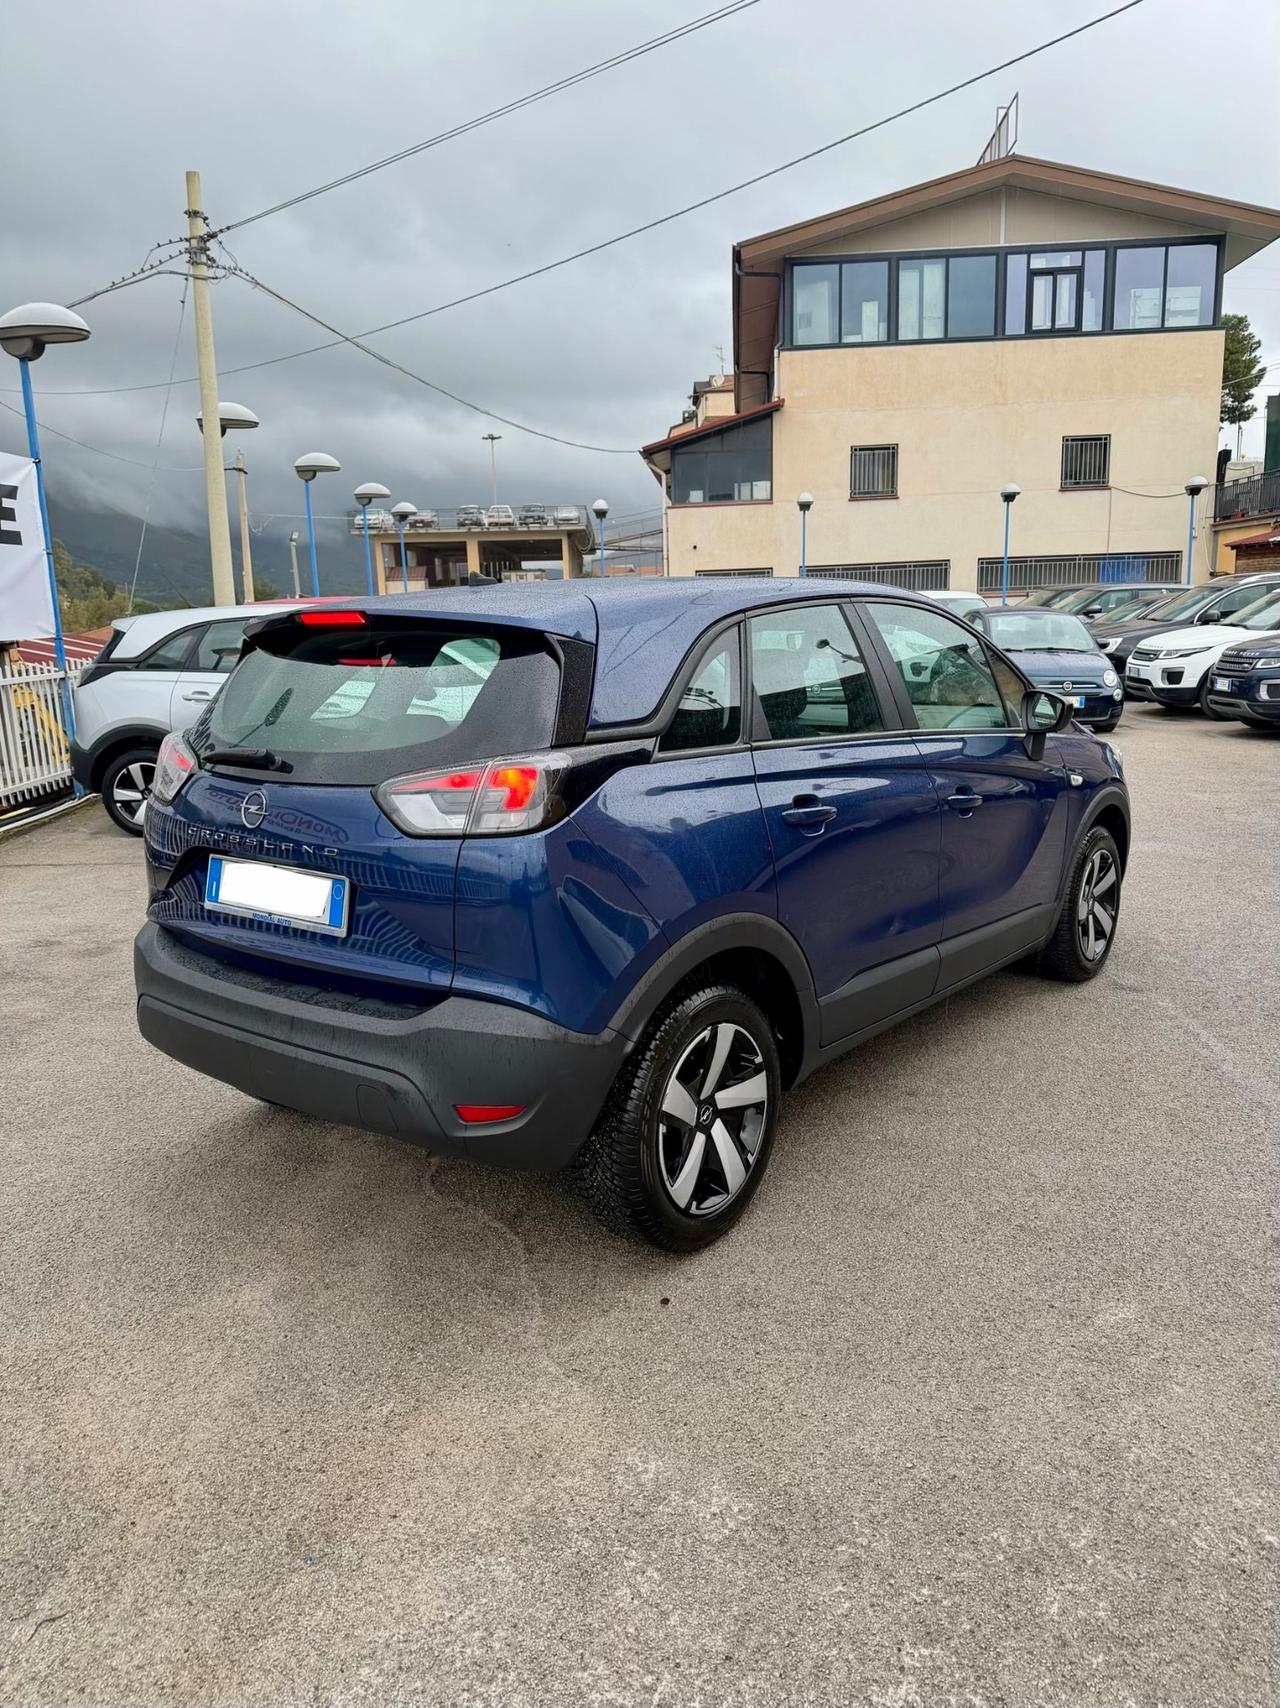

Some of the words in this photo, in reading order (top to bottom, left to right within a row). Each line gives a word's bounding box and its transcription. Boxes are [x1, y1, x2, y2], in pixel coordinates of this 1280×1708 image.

[188, 826, 339, 856] CROSSLAND
[252, 912, 276, 924] MONDIAL
[277, 917, 292, 926] AUTO
